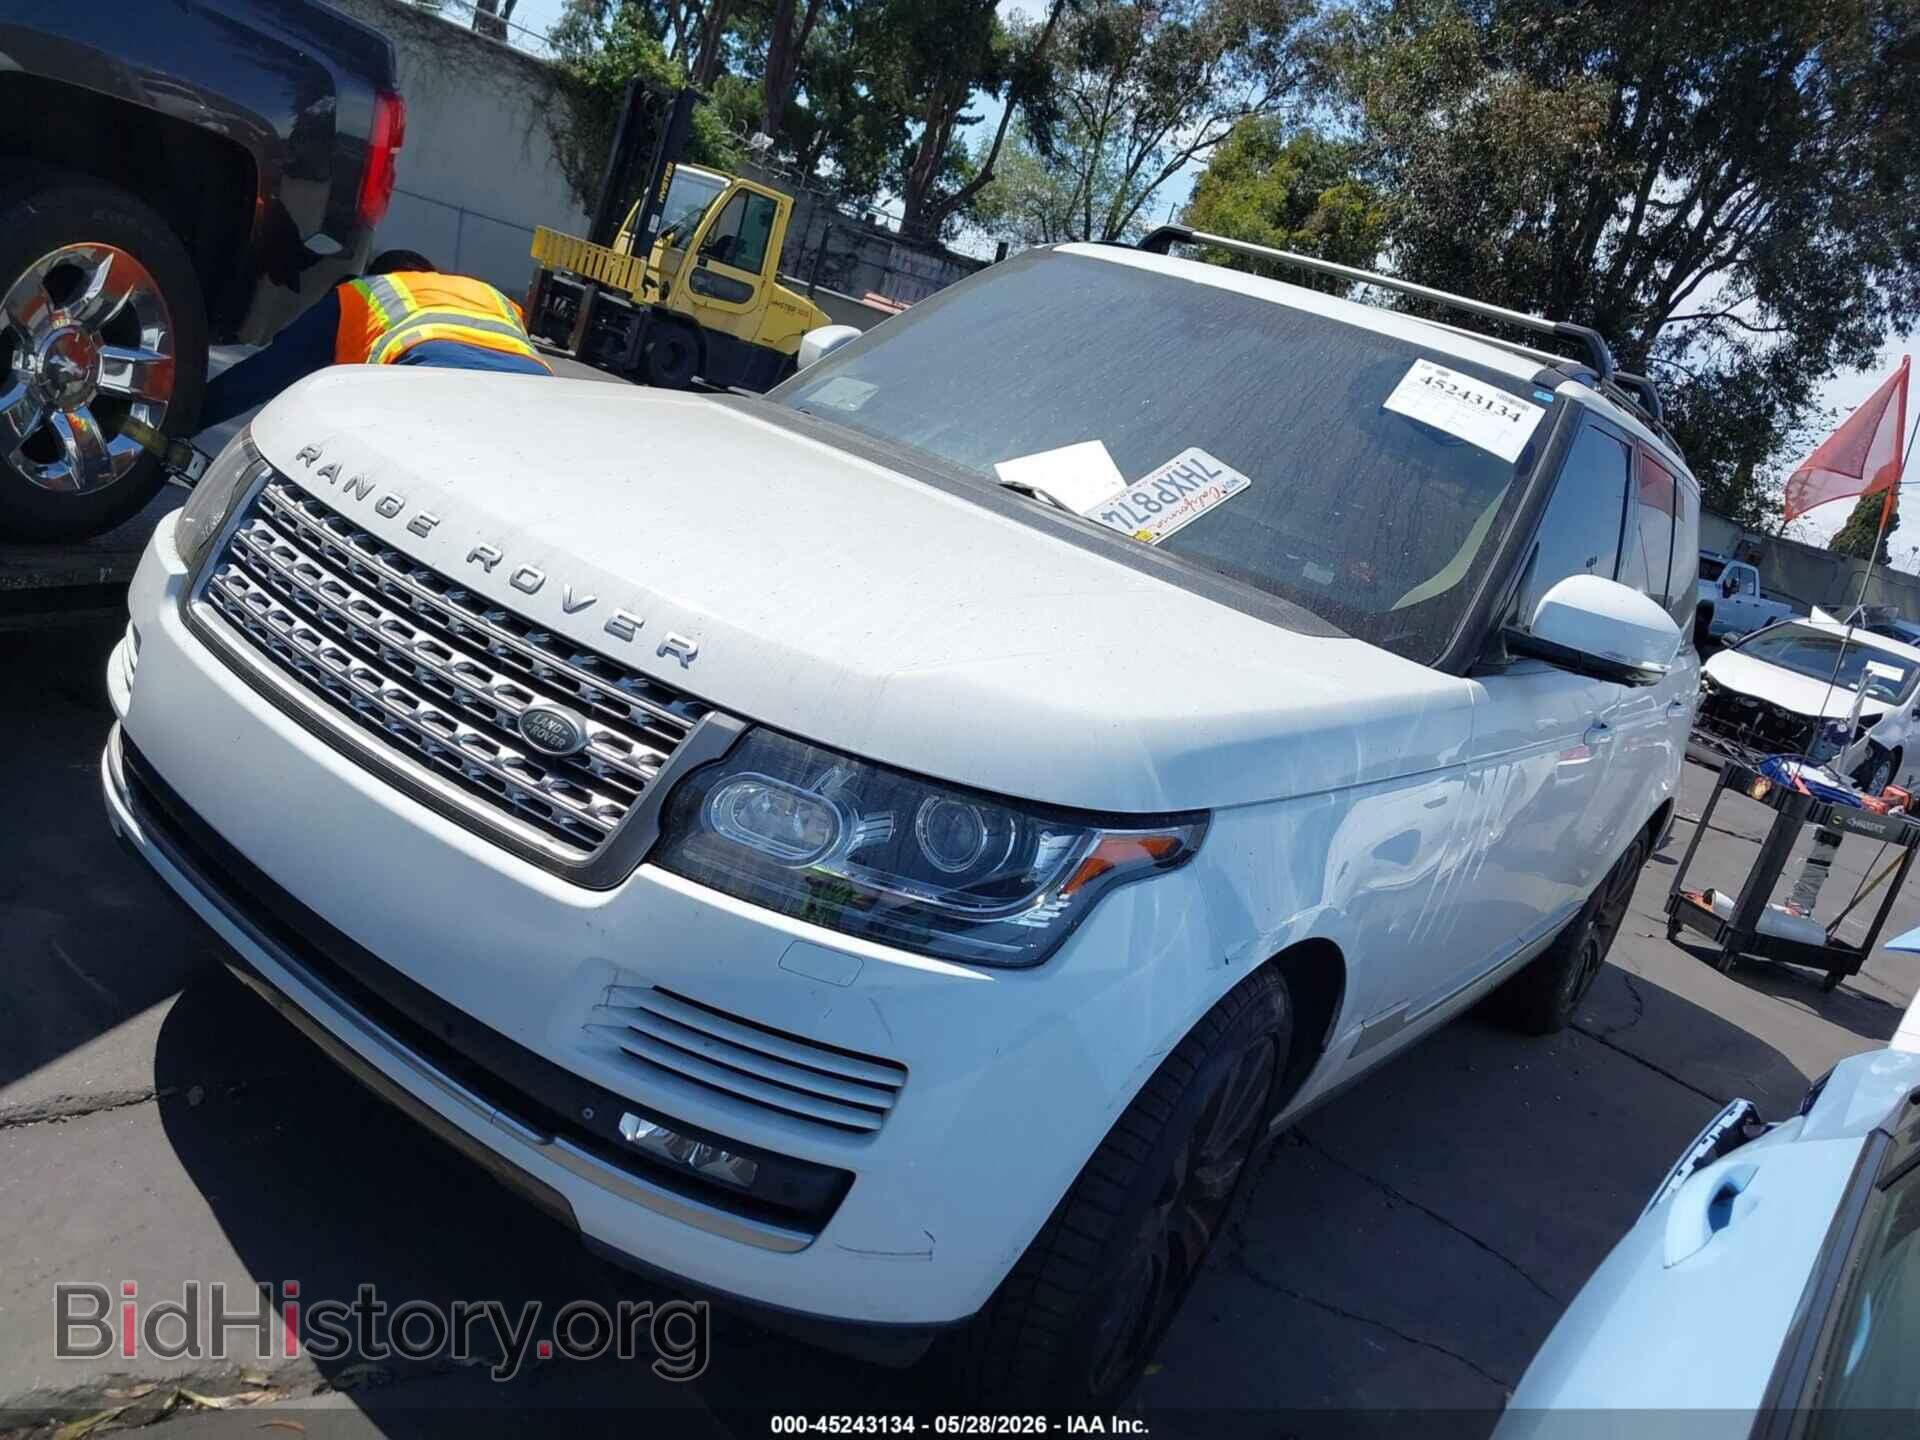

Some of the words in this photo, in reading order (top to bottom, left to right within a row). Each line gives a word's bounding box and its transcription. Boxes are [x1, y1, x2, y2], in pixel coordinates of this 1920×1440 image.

[658, 161, 674, 203] HYSTER
[1420, 376, 1521, 423] 45243134
[1100, 458, 1223, 530] 7HXP874
[1155, 486, 1221, 529] California
[296, 443, 440, 538] RANGE
[466, 541, 699, 669] ROVER
[530, 725, 566, 749] ROVER
[533, 713, 563, 734] LAND
